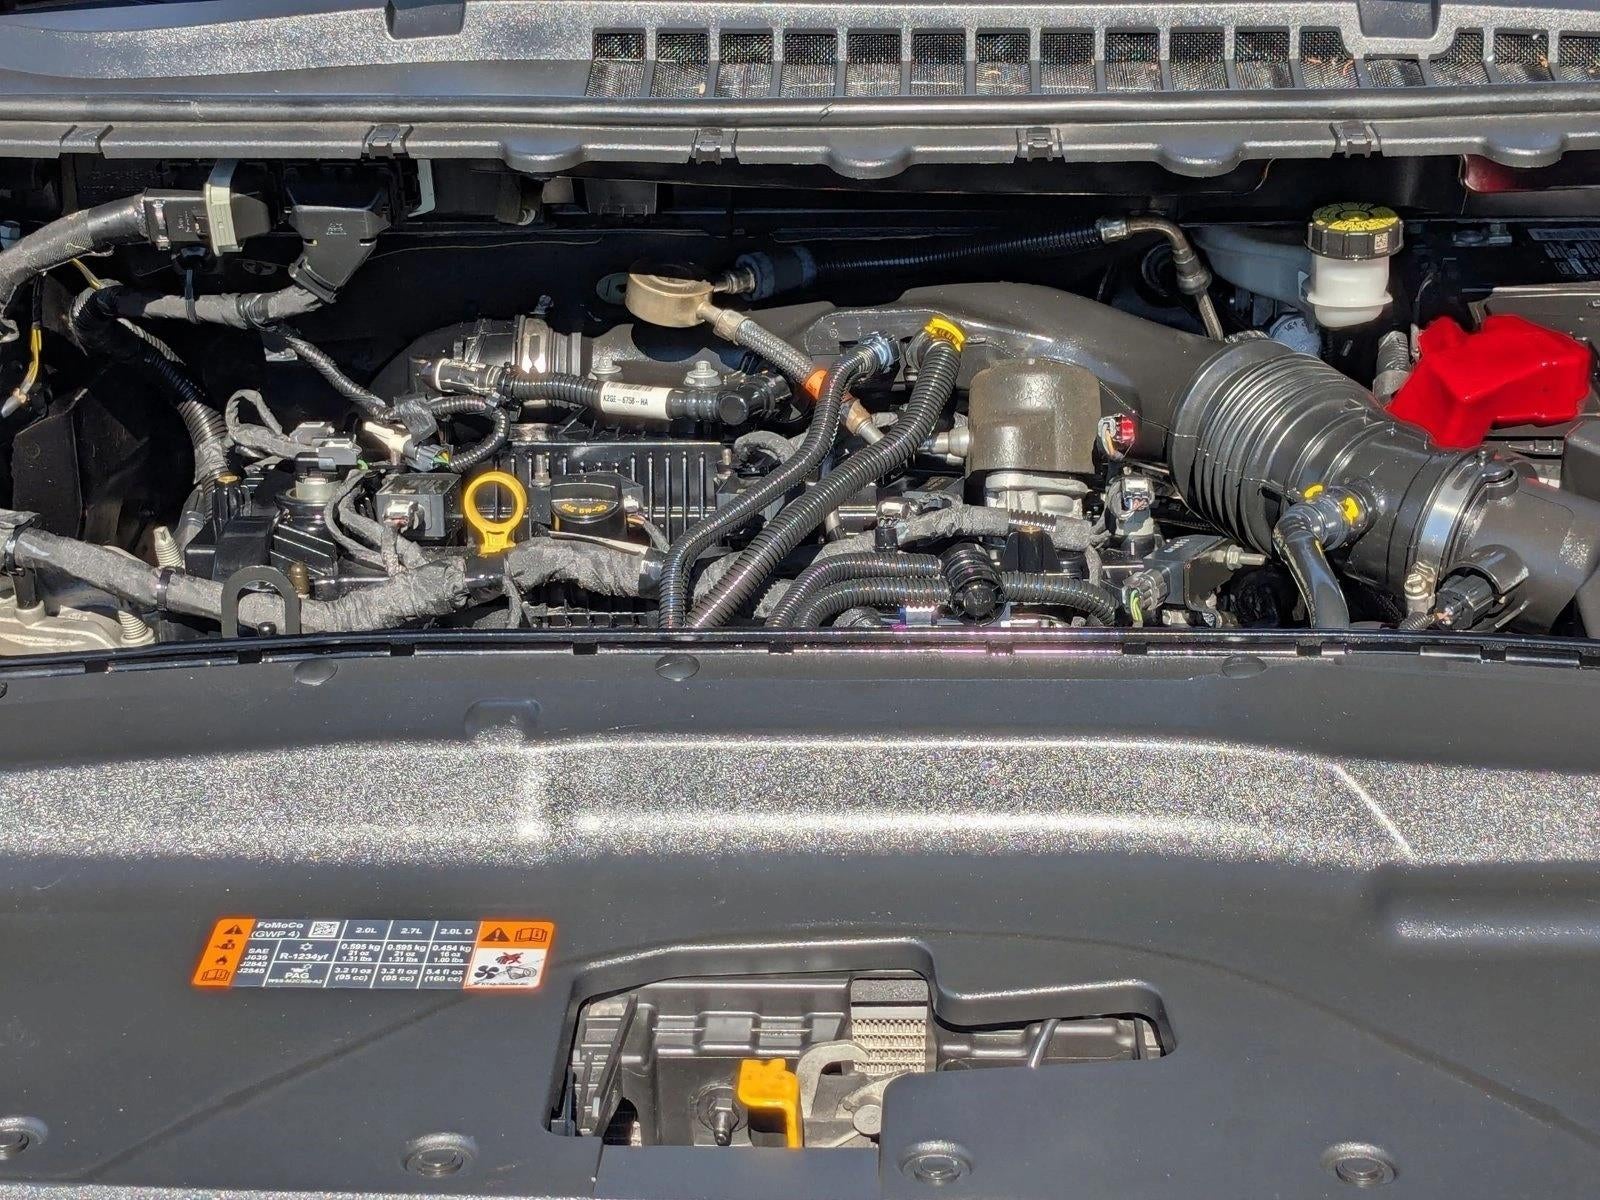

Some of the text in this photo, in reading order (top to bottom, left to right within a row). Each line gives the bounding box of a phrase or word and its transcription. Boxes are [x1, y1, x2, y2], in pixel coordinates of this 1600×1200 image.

[257, 921, 303, 929] FoMoCo
[251, 930, 286, 939] (GWP
[400, 927, 423, 935] 2.7L
[368, 943, 381, 952] kg
[413, 944, 427, 953] kg
[459, 945, 472, 953] kg
[279, 952, 329, 961] R-1234yf
[335, 974, 368, 982] (95 cc)
[381, 974, 414, 982] (95 cc)
[447, 975, 463, 983] cc)
